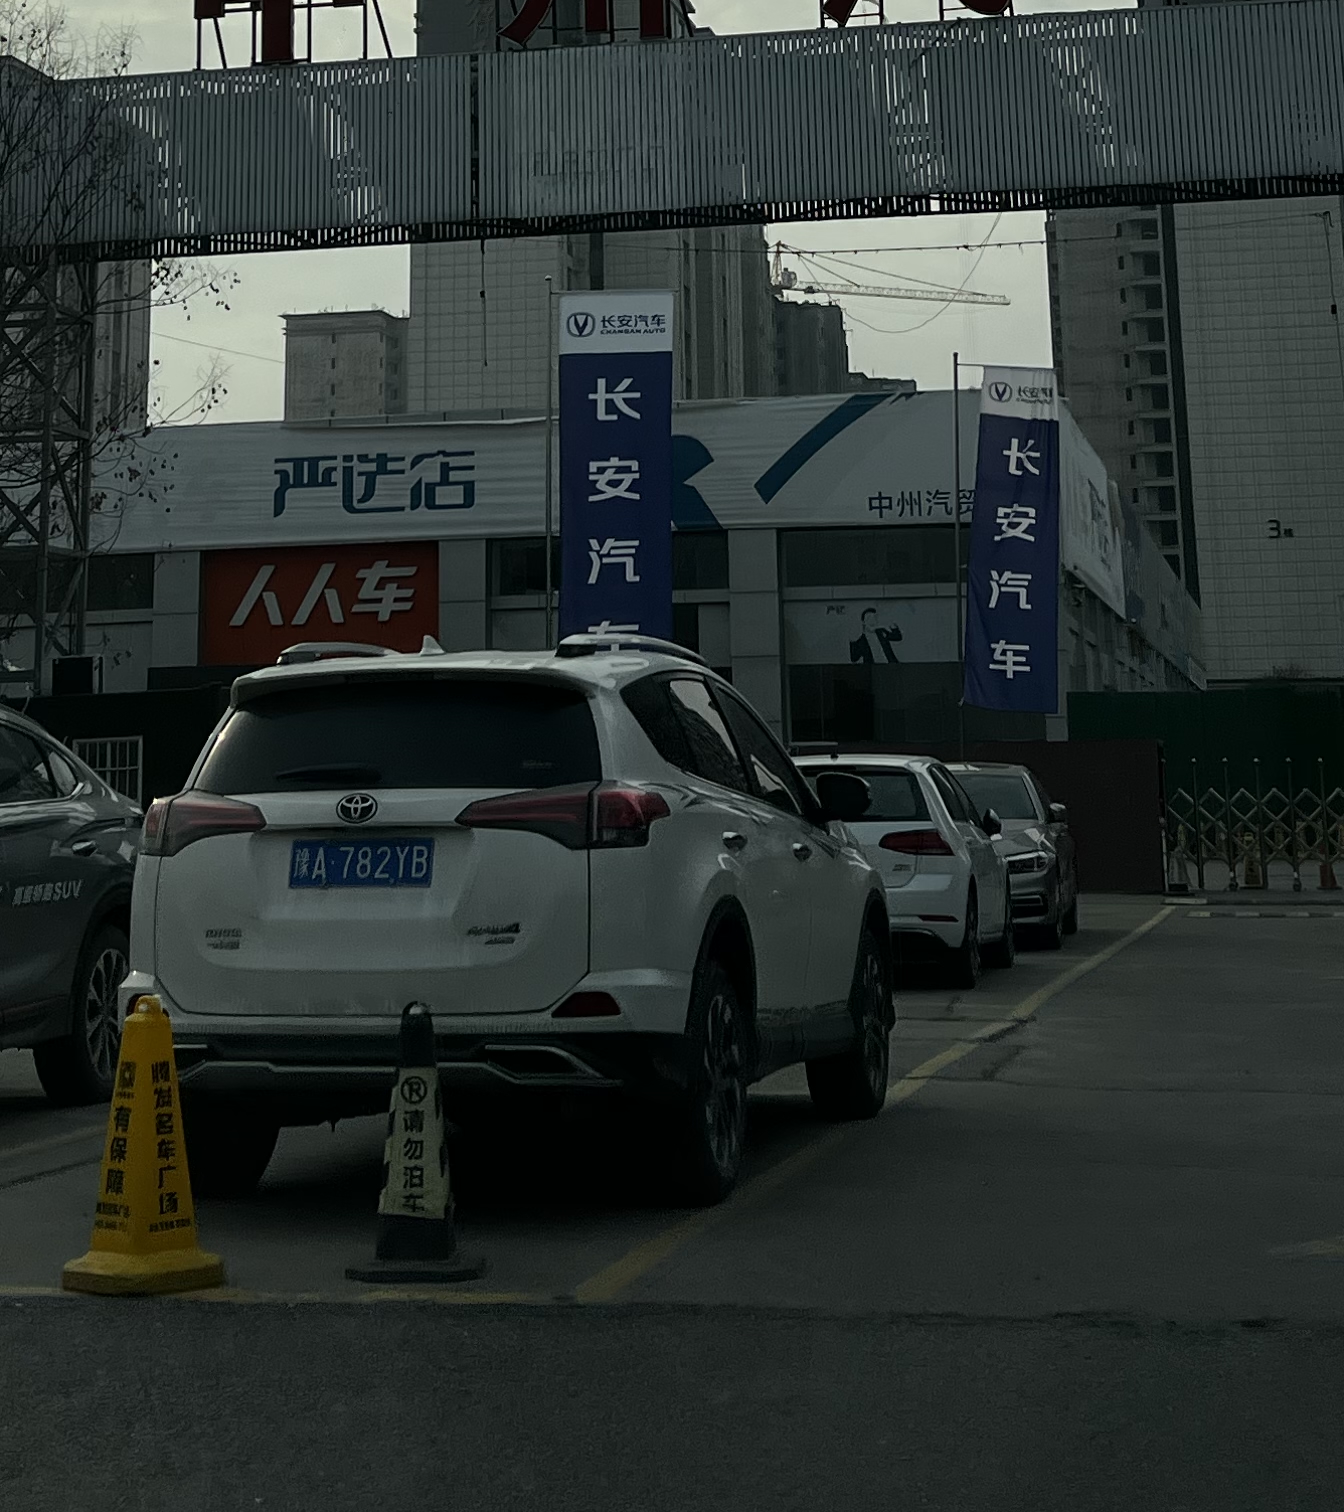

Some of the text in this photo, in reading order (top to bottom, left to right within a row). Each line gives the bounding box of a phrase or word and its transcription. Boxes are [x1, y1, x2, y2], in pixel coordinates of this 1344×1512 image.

[600, 314, 666, 328] 长安汽车
[273, 450, 475, 518] 严选店
[988, 437, 1041, 680] 长安汽车
[228, 559, 419, 627] 人人车
[402, 1109, 426, 1213] 请勿泊车
